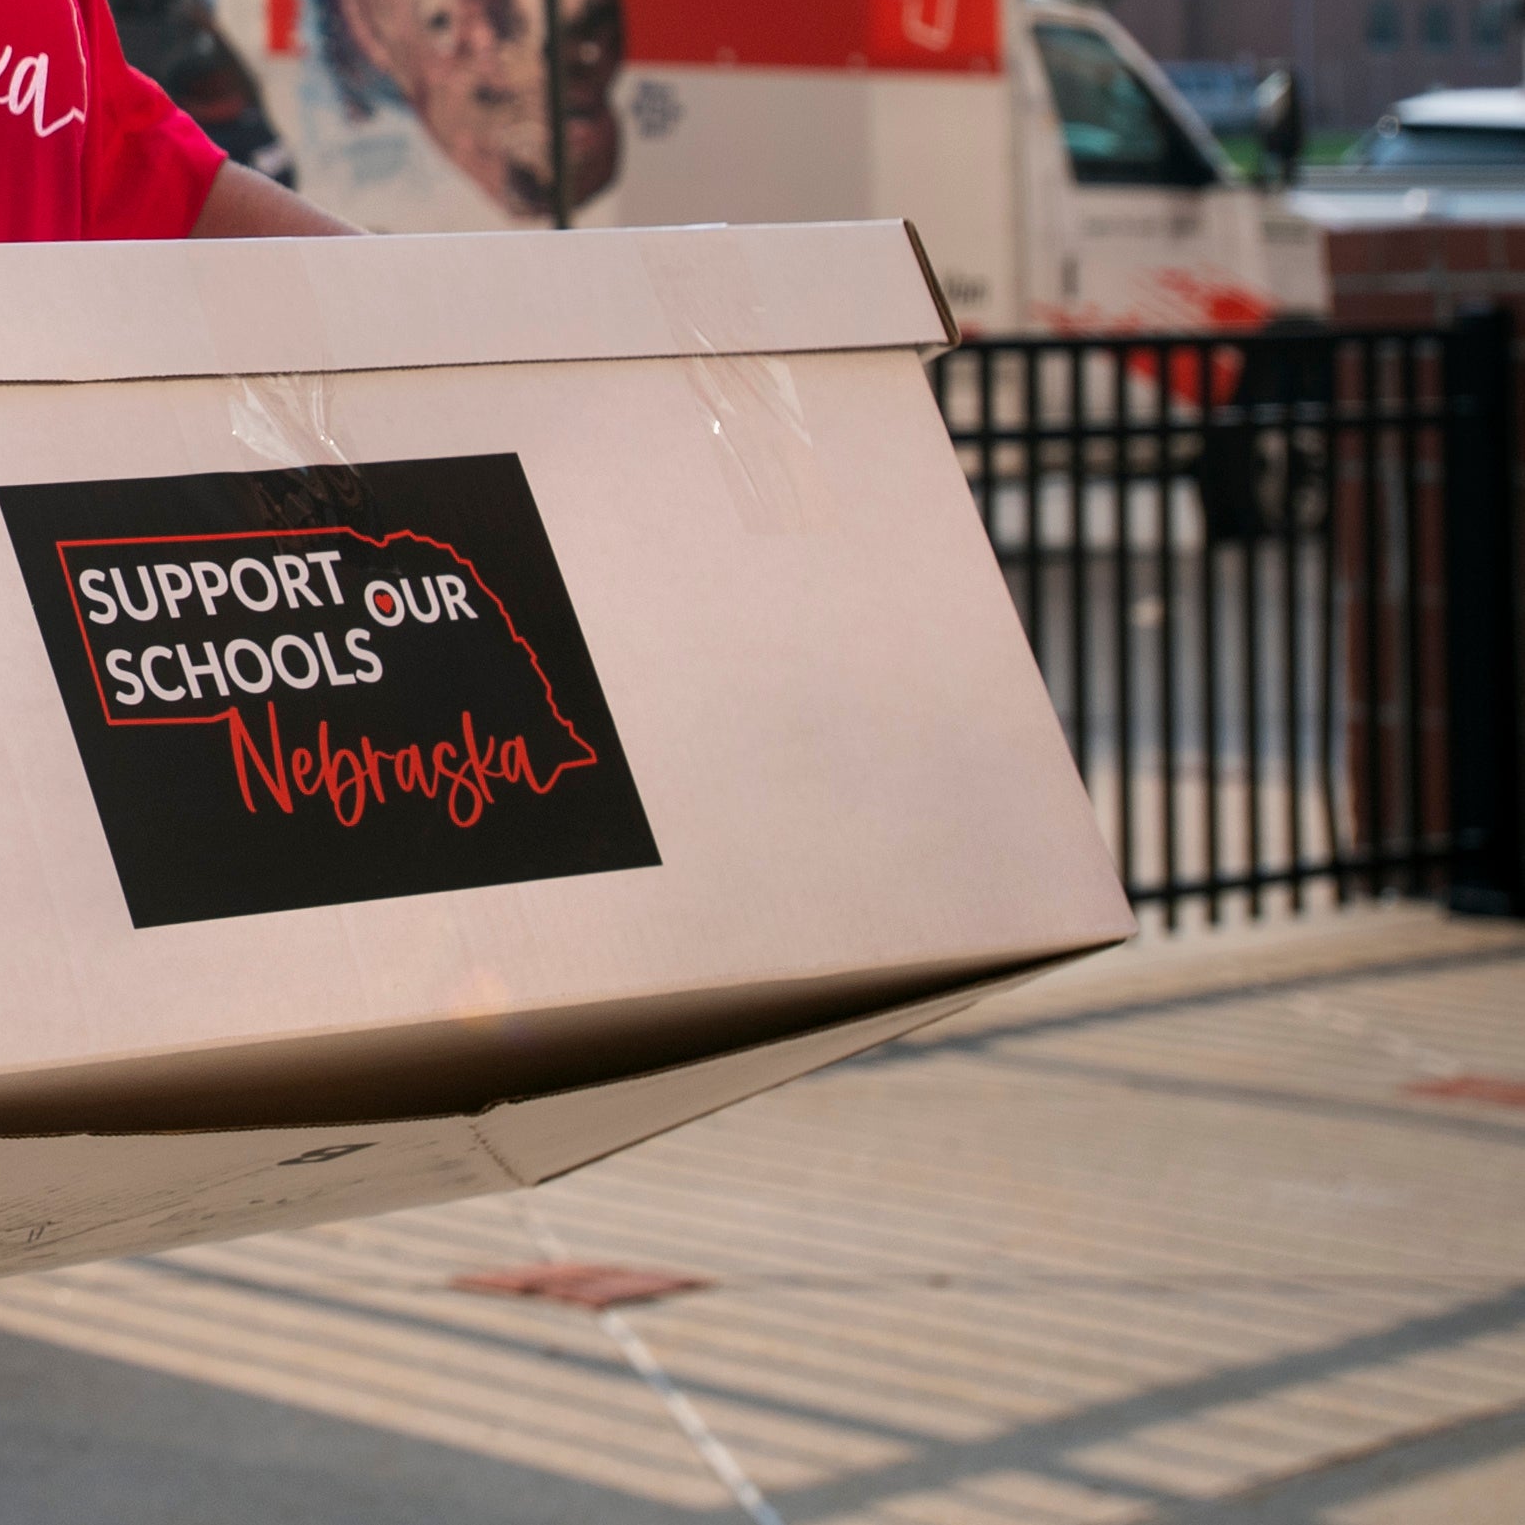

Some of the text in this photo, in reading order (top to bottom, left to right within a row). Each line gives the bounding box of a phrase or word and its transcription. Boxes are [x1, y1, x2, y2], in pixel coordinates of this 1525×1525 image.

[79, 550, 479, 627] SUPPORT OUR
[105, 628, 383, 705] SCHOOLS
[230, 701, 553, 828] Nebraska
